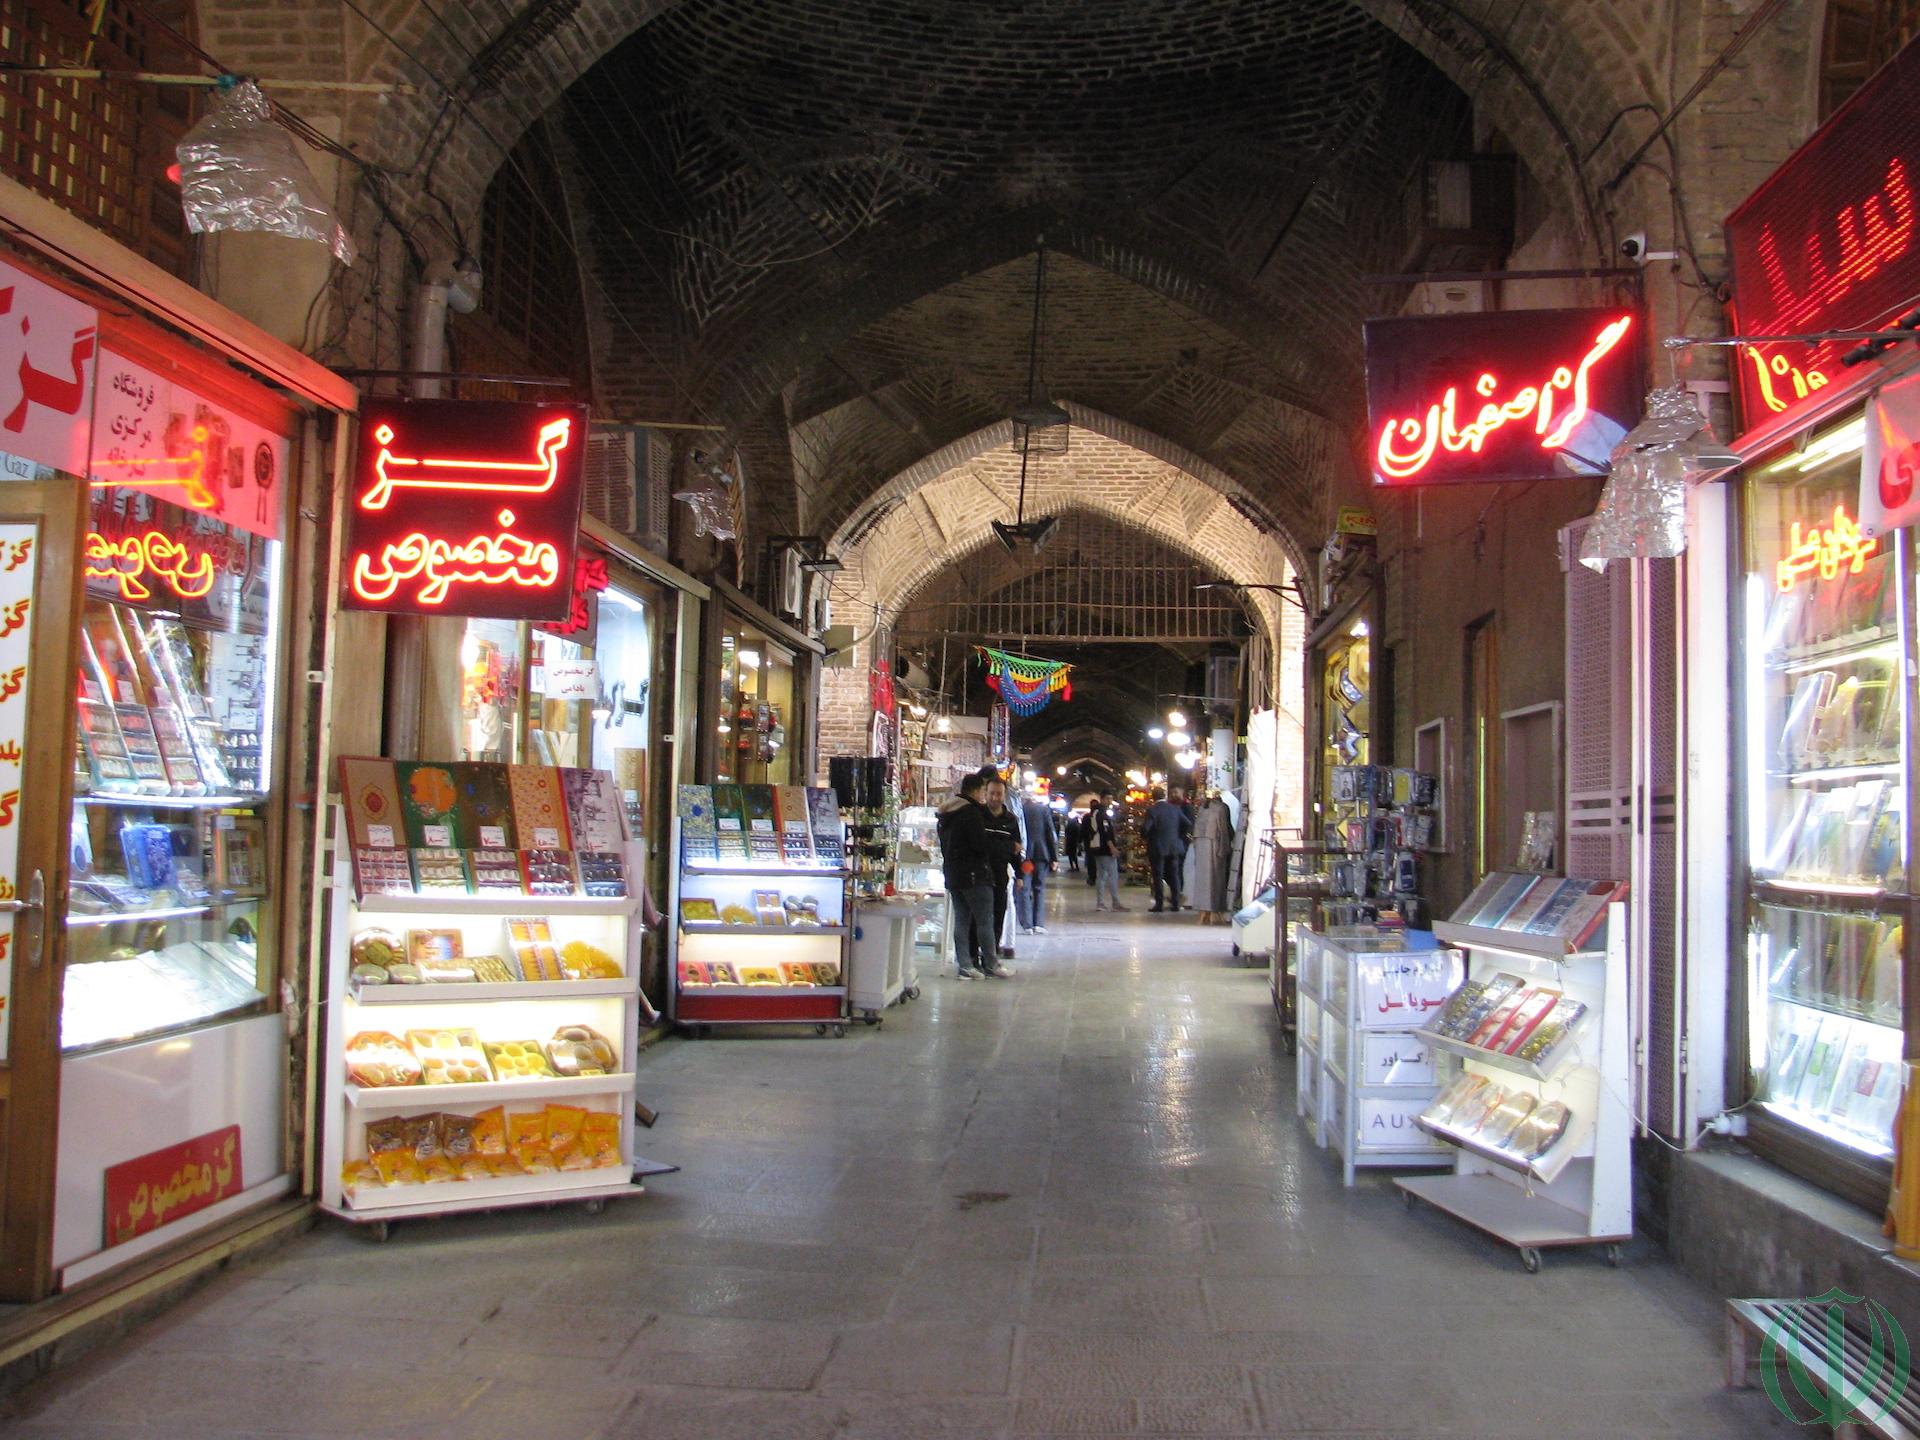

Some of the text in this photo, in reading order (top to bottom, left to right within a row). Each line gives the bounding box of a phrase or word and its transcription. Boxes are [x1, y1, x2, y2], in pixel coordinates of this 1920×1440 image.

[3, 315, 97, 434] گز
[1378, 316, 1632, 477] گز اصفهان
[360, 416, 571, 510] گز
[4, 538, 33, 571] گز
[353, 508, 560, 605] مخصوص
[0, 598, 30, 638] گز
